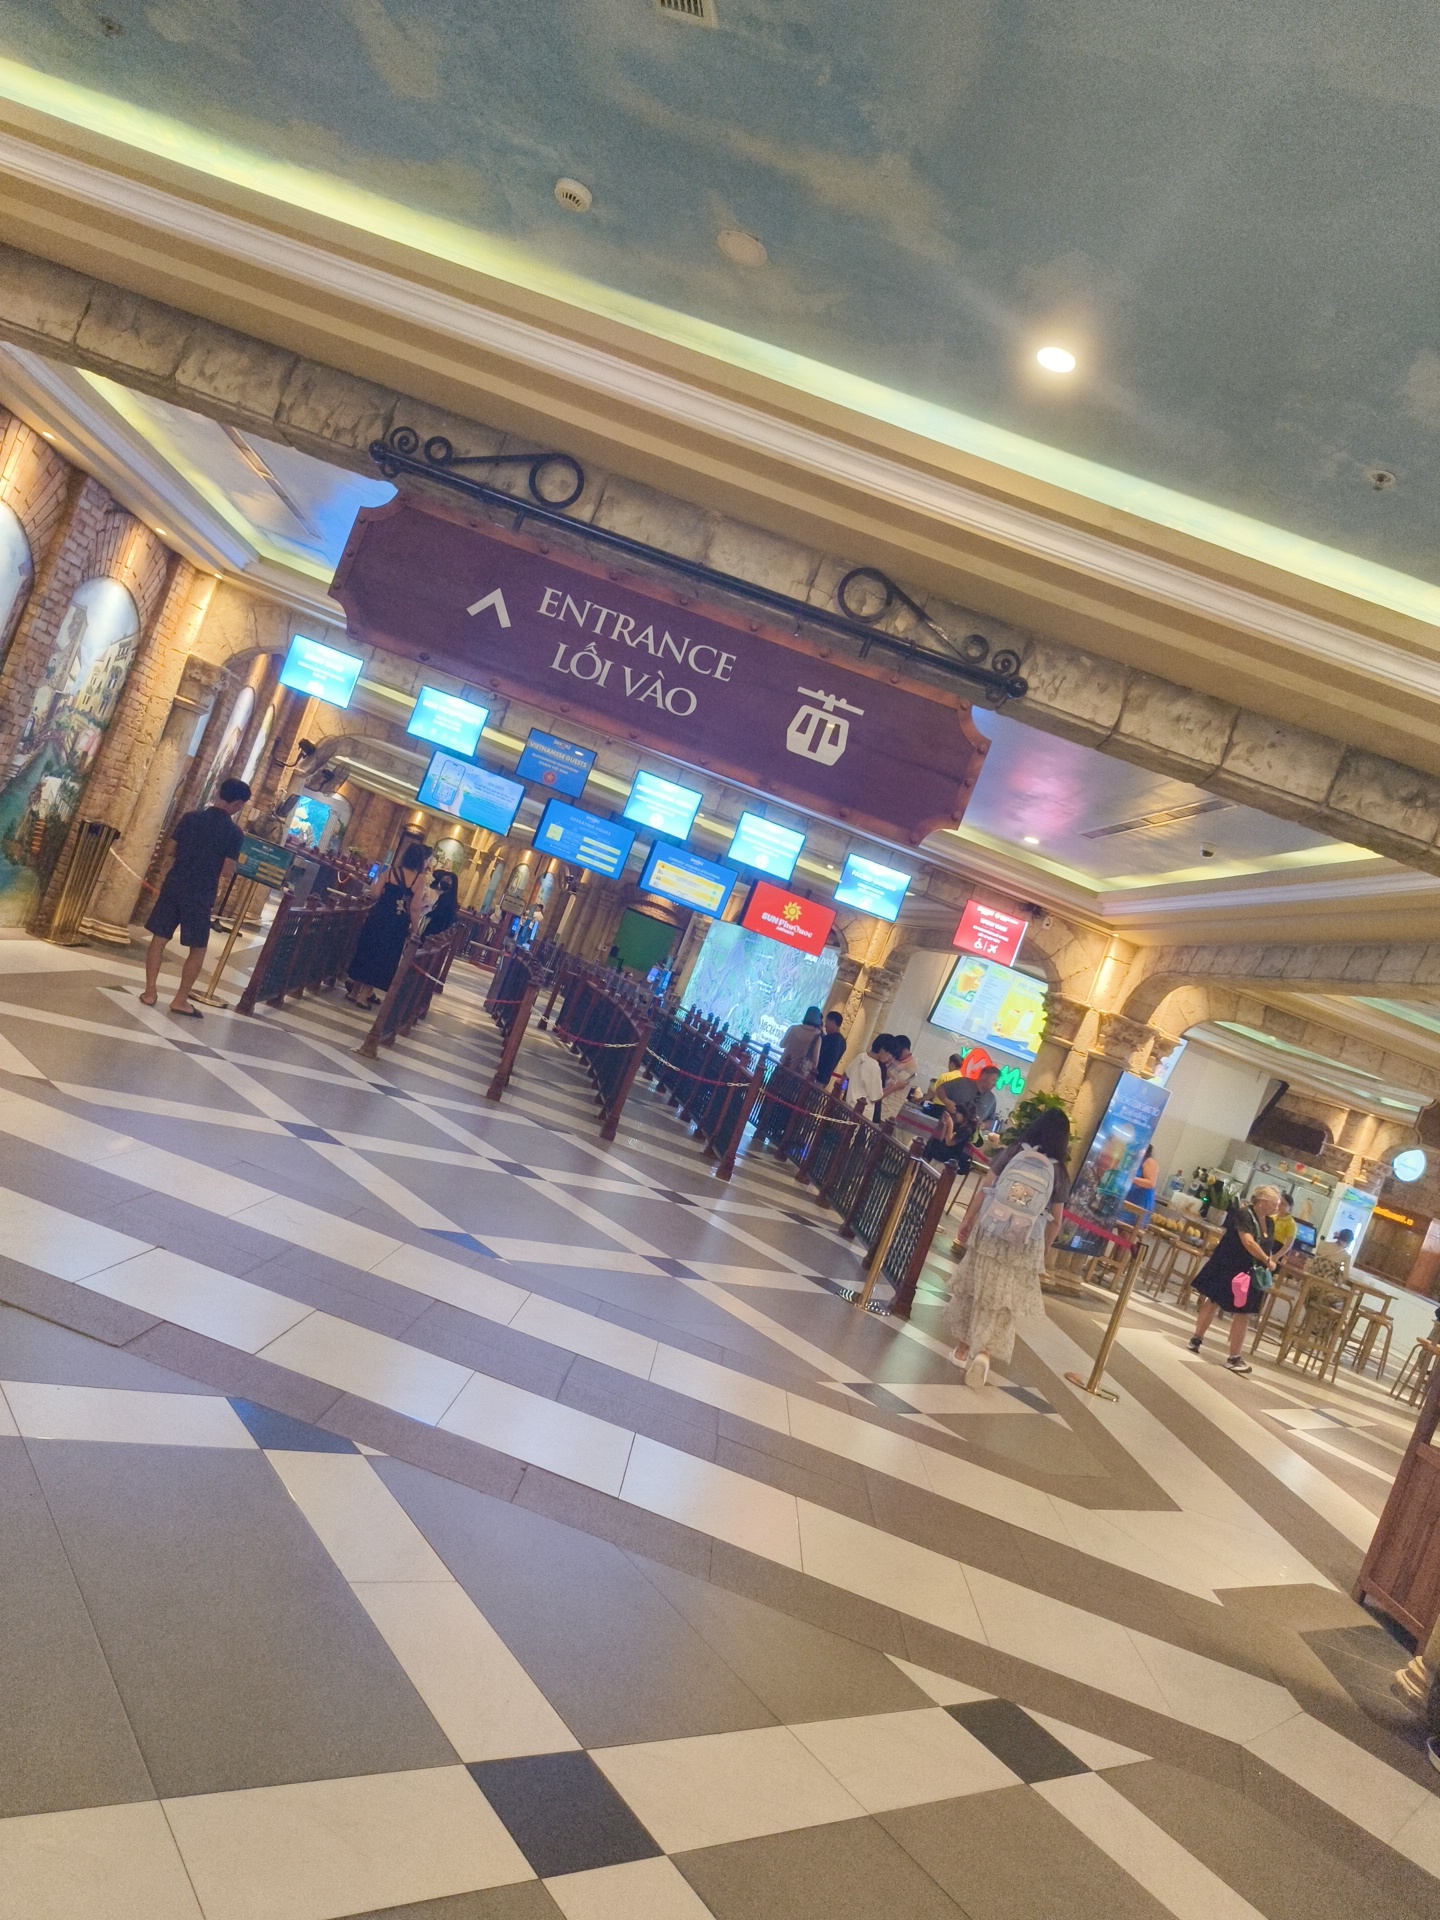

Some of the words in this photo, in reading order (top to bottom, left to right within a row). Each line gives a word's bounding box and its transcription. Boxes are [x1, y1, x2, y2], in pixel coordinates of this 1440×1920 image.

[536, 586, 737, 682] ENTRANCE
[550, 641, 615, 688] LỐI
[622, 665, 698, 717] VÀO
[529, 741, 566, 759] VIETNAMESE
[594, 825, 611, 836] HOURS
[760, 911, 780, 925] SUN
